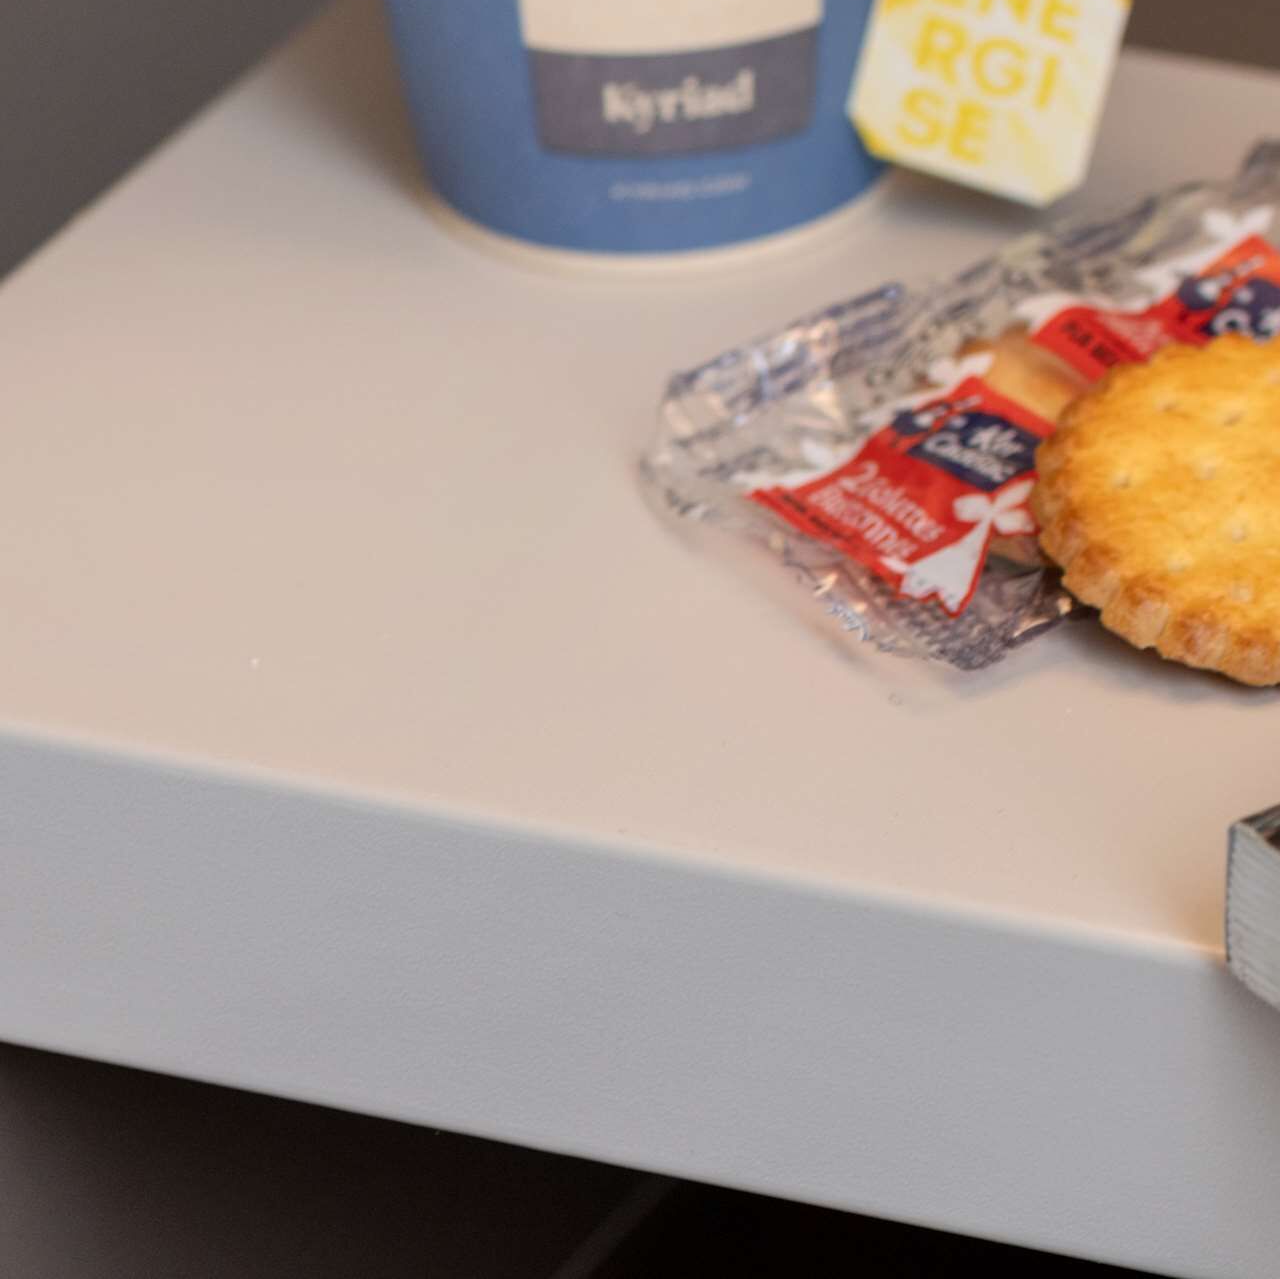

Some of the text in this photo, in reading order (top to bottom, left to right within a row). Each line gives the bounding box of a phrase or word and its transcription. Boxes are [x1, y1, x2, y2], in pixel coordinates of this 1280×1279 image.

[602, 70, 756, 133] Kyriad
[914, 17, 1063, 110] RGI
[896, 88, 990, 165] SE
